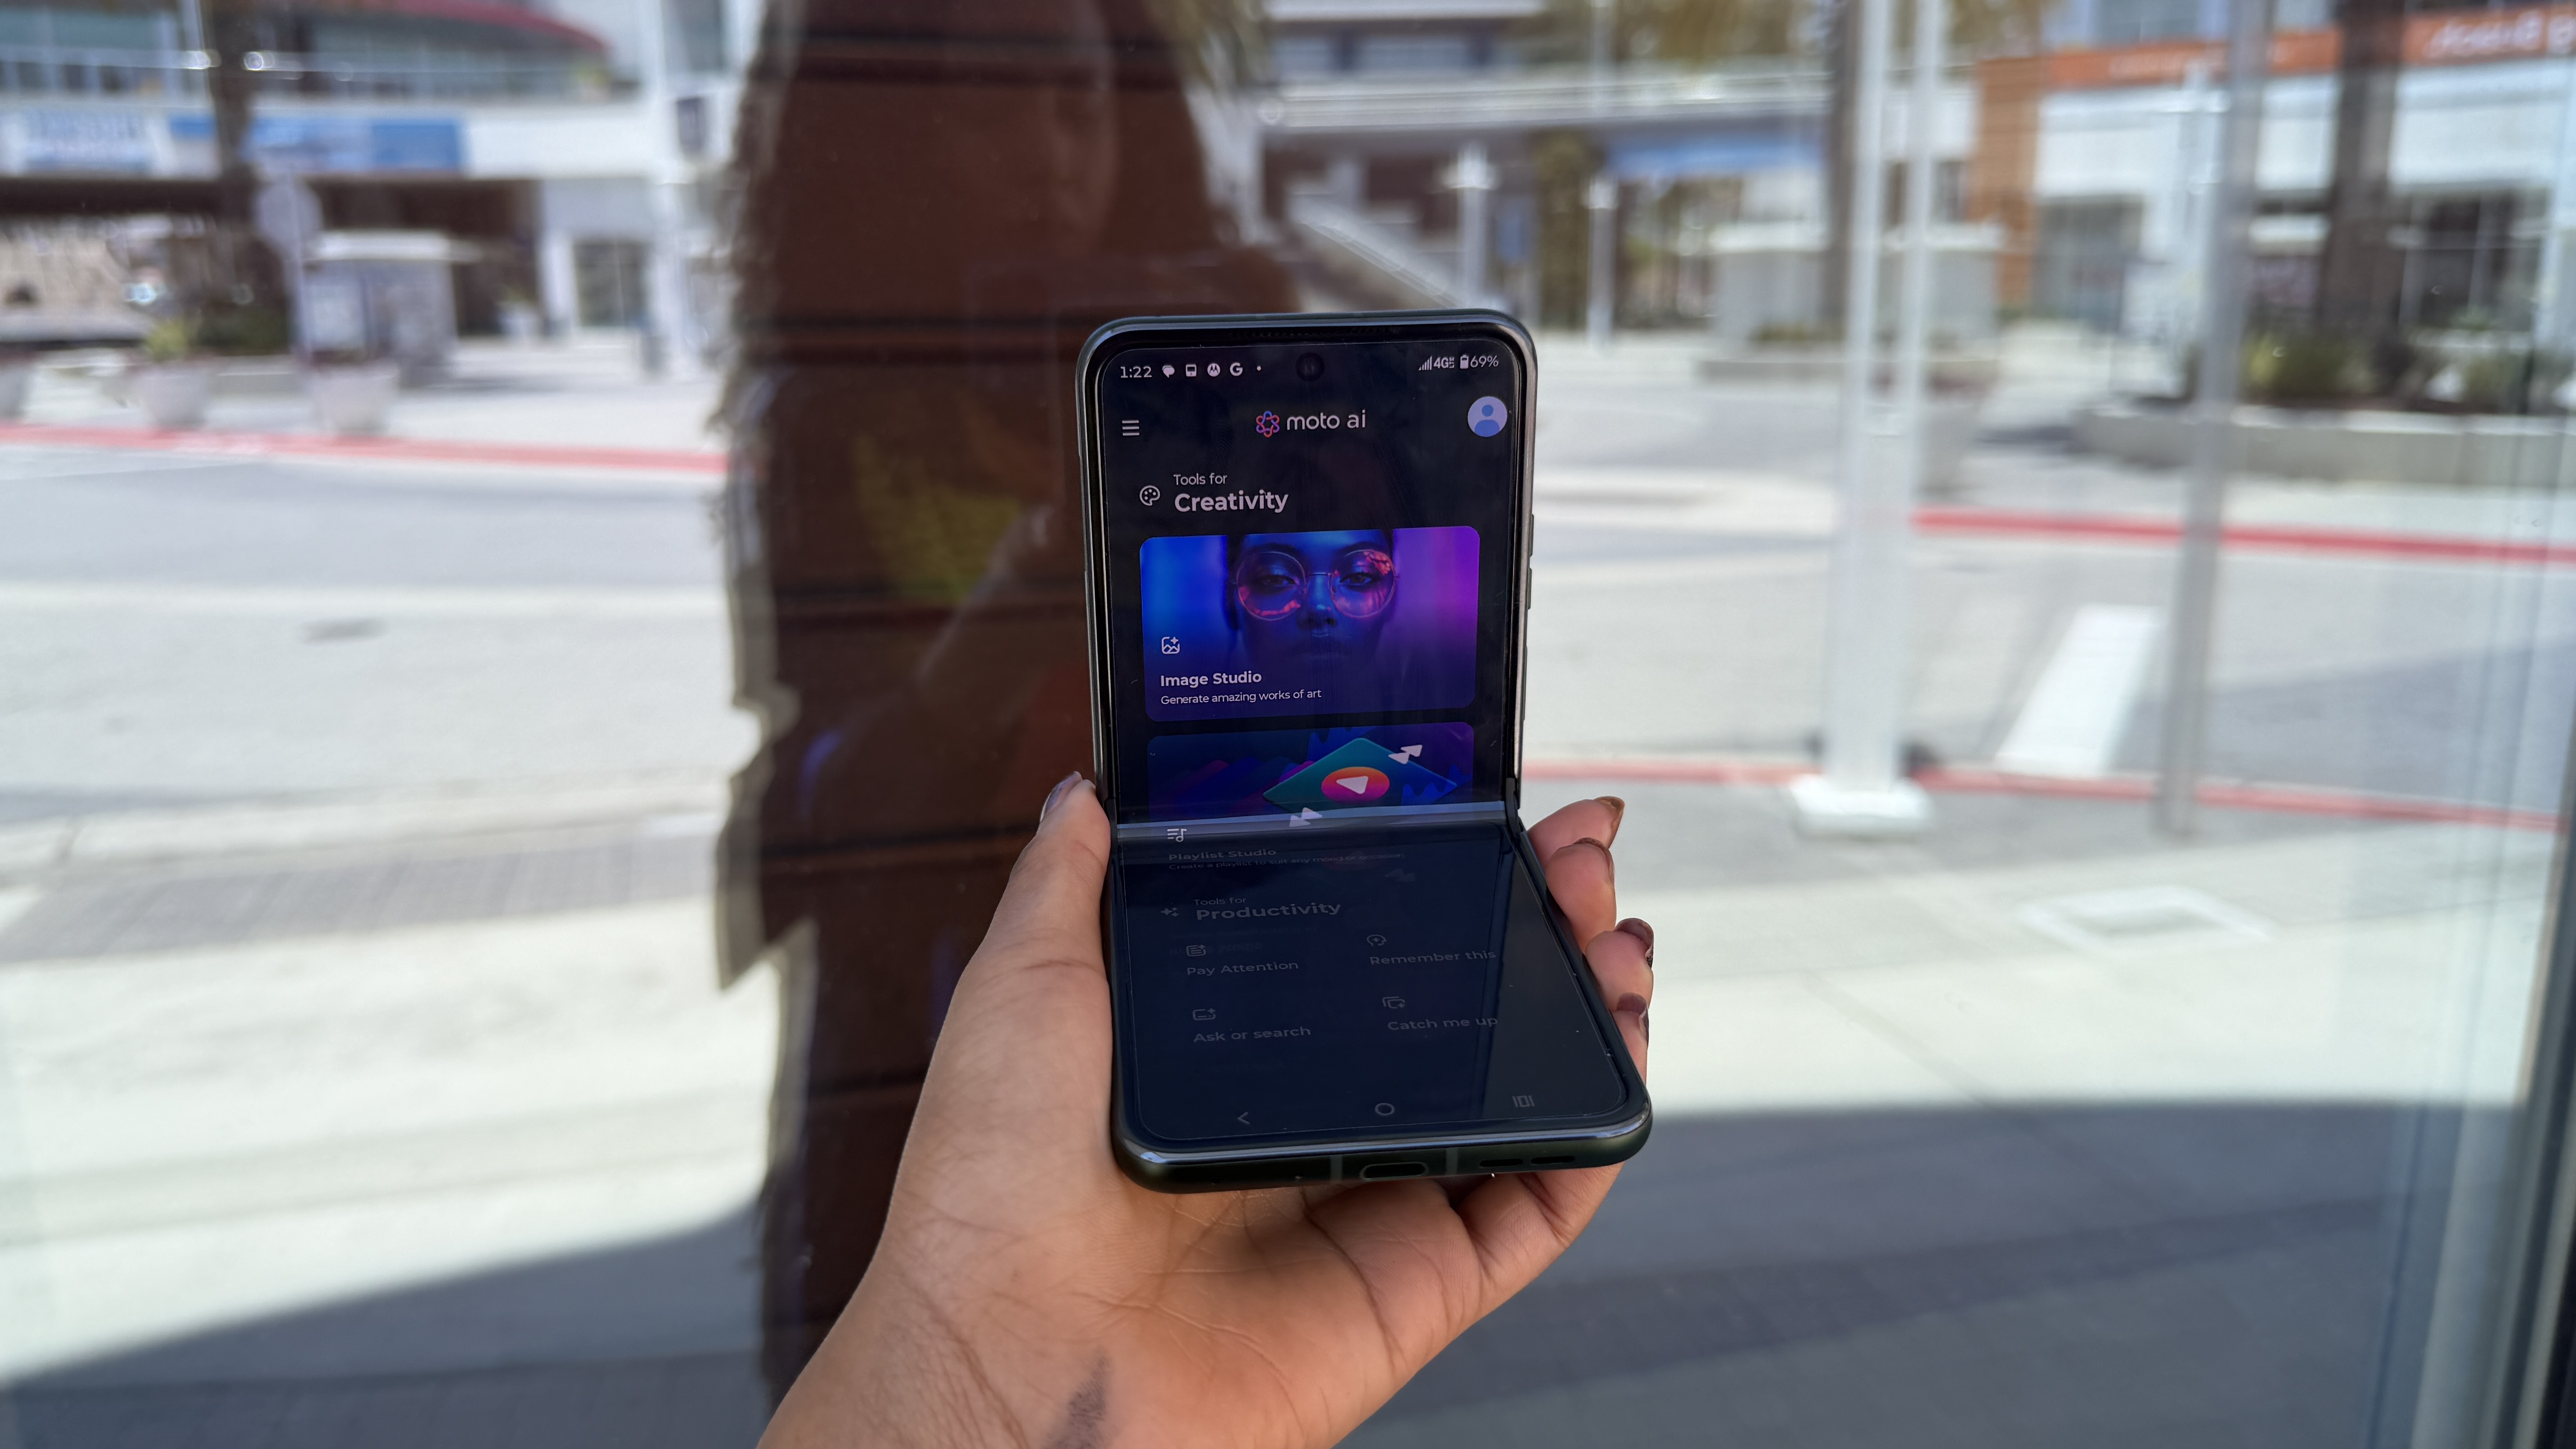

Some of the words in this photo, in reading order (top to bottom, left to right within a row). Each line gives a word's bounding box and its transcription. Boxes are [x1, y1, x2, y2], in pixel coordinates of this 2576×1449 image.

[1470, 355, 1499, 367] 69%
[1121, 366, 1152, 378] 1:22
[1286, 413, 1340, 430] moto
[1347, 409, 1366, 428] ai
[1173, 473, 1205, 485] Tools
[1210, 473, 1227, 484] for
[1174, 490, 1288, 513] Creativity
[1160, 675, 1209, 689] Image
[1213, 671, 1262, 685] Studio
[1161, 694, 1210, 704] Generate
[1212, 692, 1256, 703] amazing
[1259, 690, 1290, 700] works
[1293, 689, 1305, 699] of
[1307, 690, 1322, 698] art
[1169, 851, 1223, 860] Playlist
[1227, 849, 1277, 857] Studio
[1196, 902, 1341, 920] Productivity
[1370, 952, 1460, 965] Remember
[1465, 950, 1496, 960] this
[1187, 968, 1214, 977] Pay
[1221, 962, 1299, 974] Attention
[1388, 1019, 1438, 1030] Catch
[1444, 1019, 1470, 1027] me
[1476, 1017, 1498, 1028] up
[1193, 1032, 1227, 1043] Ask
[1231, 1032, 1247, 1040] or
[1253, 1026, 1311, 1039] search
